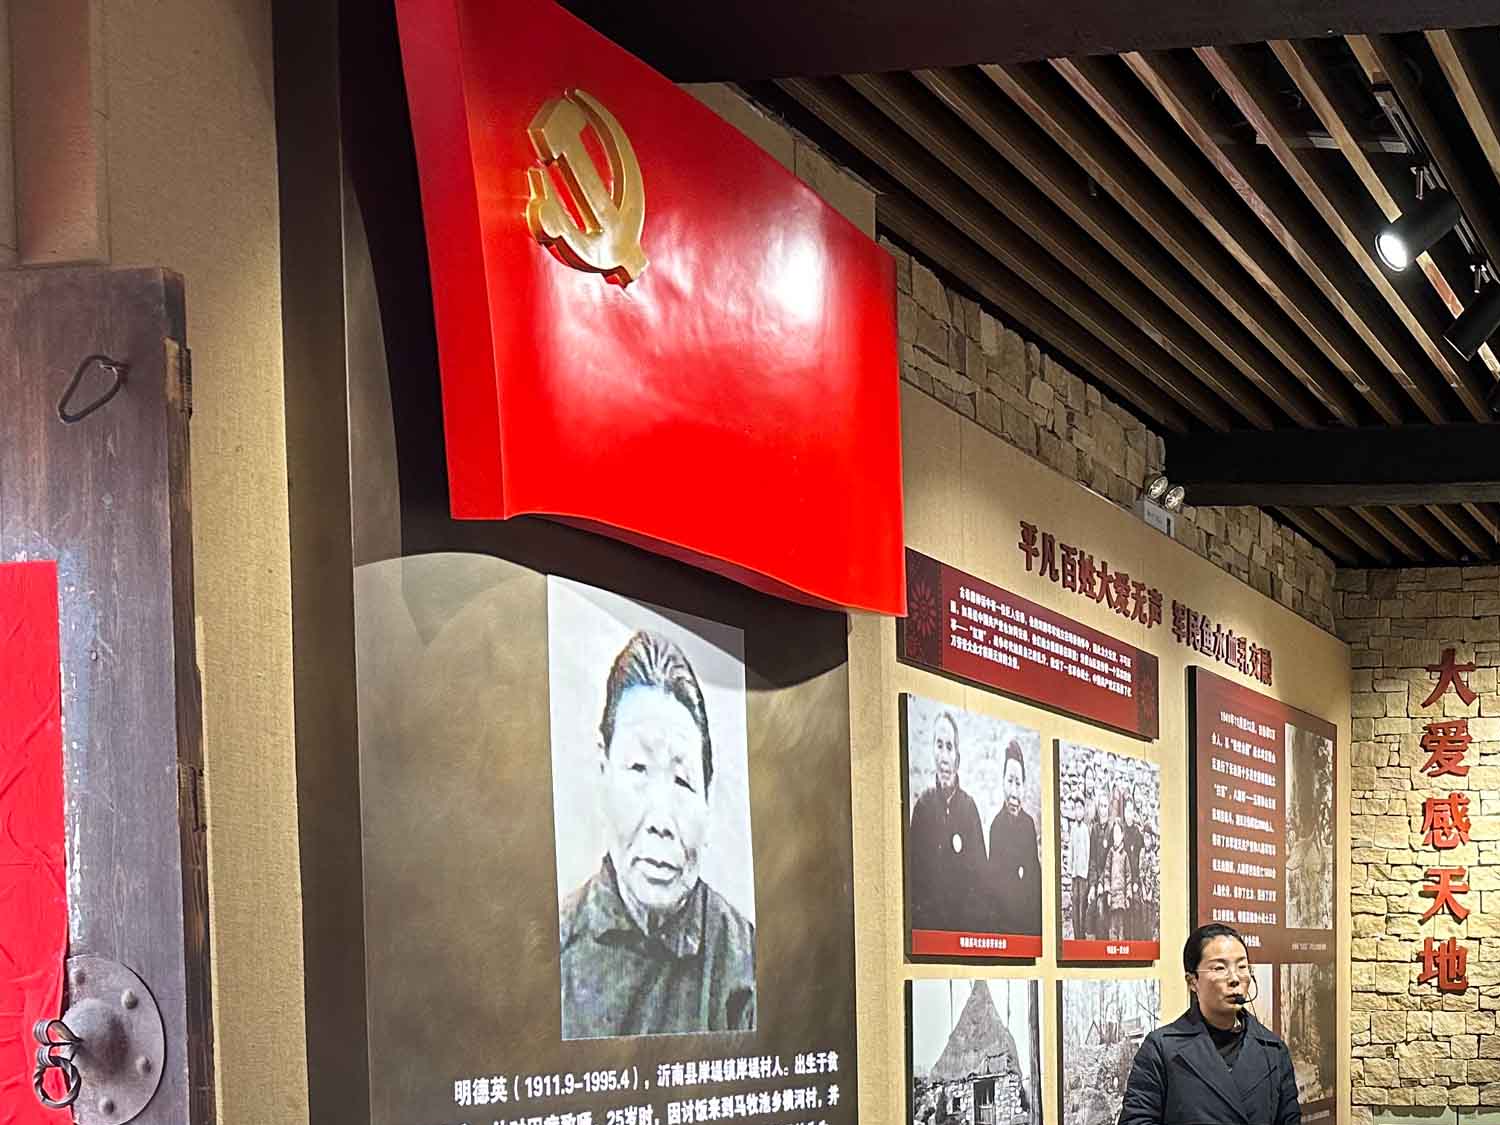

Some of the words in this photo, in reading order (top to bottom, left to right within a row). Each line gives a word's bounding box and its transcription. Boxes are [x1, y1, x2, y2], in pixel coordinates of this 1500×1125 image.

[1018, 520, 1163, 628] 平凡百姓大爱无声
[1418, 648, 1478, 995] 大爱感天地
